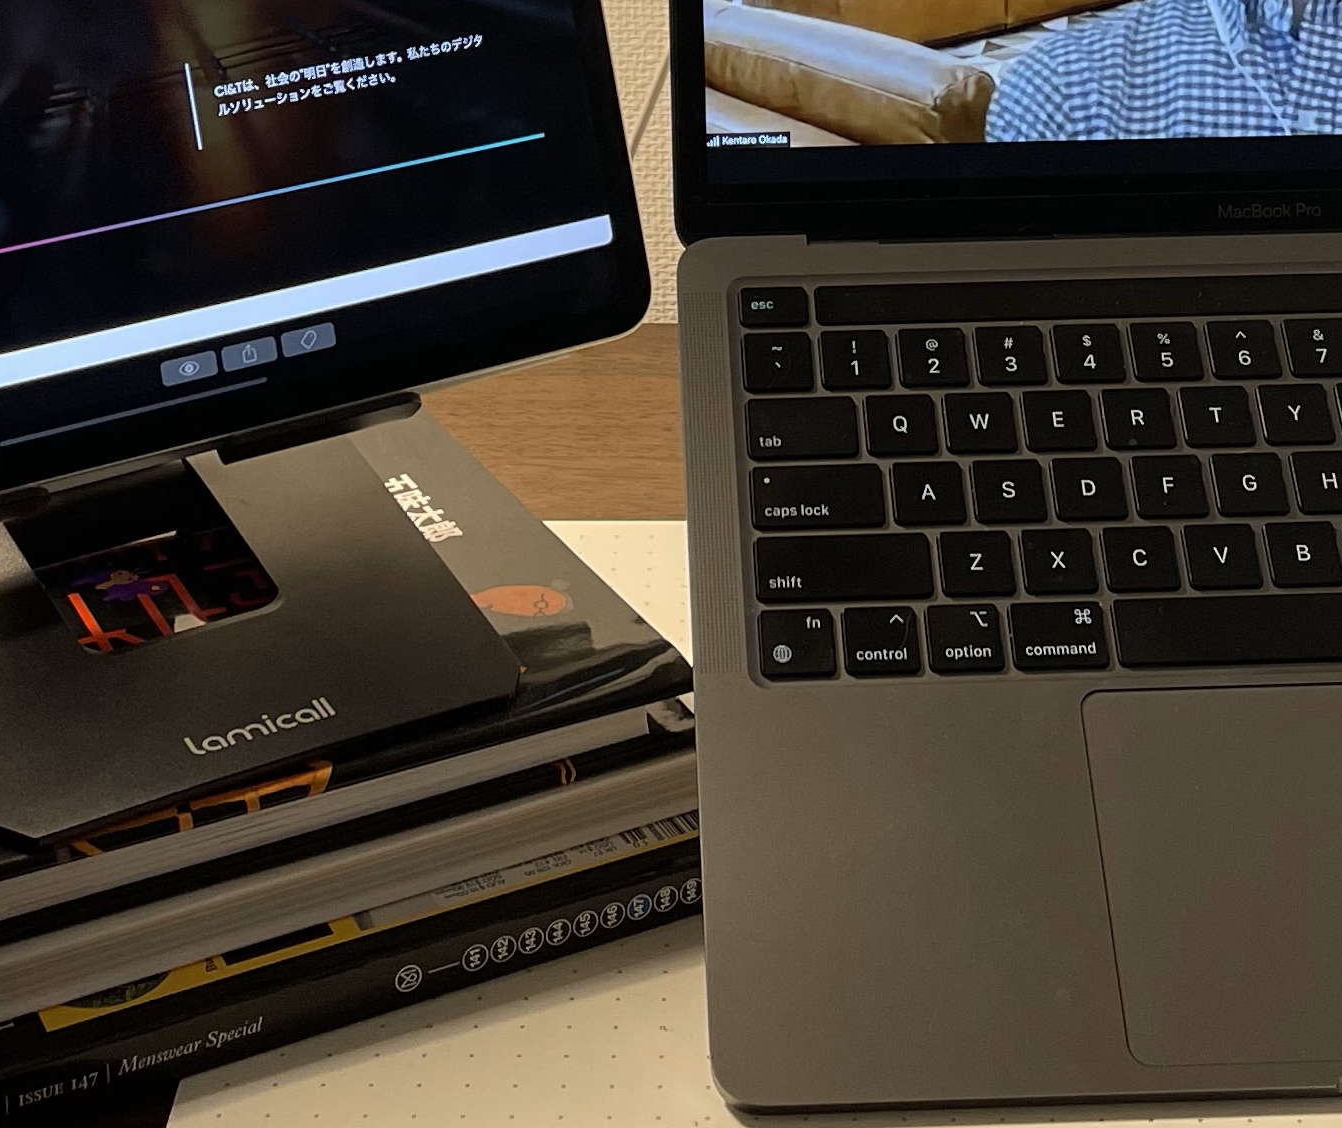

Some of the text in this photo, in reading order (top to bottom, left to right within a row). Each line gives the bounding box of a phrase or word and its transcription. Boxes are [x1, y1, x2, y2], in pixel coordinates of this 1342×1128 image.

[722, 134, 788, 146] Kentaro Okada
[1217, 202, 1322, 219] MacBook Pro
[750, 300, 774, 310] esc
[1004, 356, 1018, 372] 3
[1083, 354, 1097, 369] 4
[1160, 351, 1174, 368] 5
[1238, 349, 1252, 366] 6
[1315, 348, 1328, 364] 7
[850, 360, 859, 376] 1
[927, 358, 941, 374] 2
[1051, 411, 1065, 428] E
[1130, 409, 1145, 426] R
[1208, 406, 1222, 423] T
[1287, 404, 1301, 421] Y
[892, 415, 908, 434] Q
[969, 413, 990, 430] W
[759, 435, 782, 448] tab
[1080, 479, 1096, 496] D
[1162, 476, 1174, 494] F
[1242, 474, 1258, 492] G
[1321, 472, 1339, 490] H
[921, 483, 937, 501] A
[1001, 481, 1016, 499] S
[384, 473, 464, 543] 五味太郎
[764, 503, 830, 519] caps lock
[1050, 551, 1066, 569] X
[1132, 548, 1148, 567] C
[1213, 546, 1228, 564] V
[1295, 544, 1311, 562] B
[969, 553, 984, 571] Z
[769, 575, 802, 589] shift
[806, 616, 821, 629] fn
[856, 647, 908, 661] control
[945, 644, 992, 661] option
[1025, 641, 1097, 656] command
[18, 1082, 64, 1108] ISSUE
[71, 1071, 99, 1093] 147
[118, 1039, 203, 1076] Menswear
[206, 1017, 263, 1050] Special
